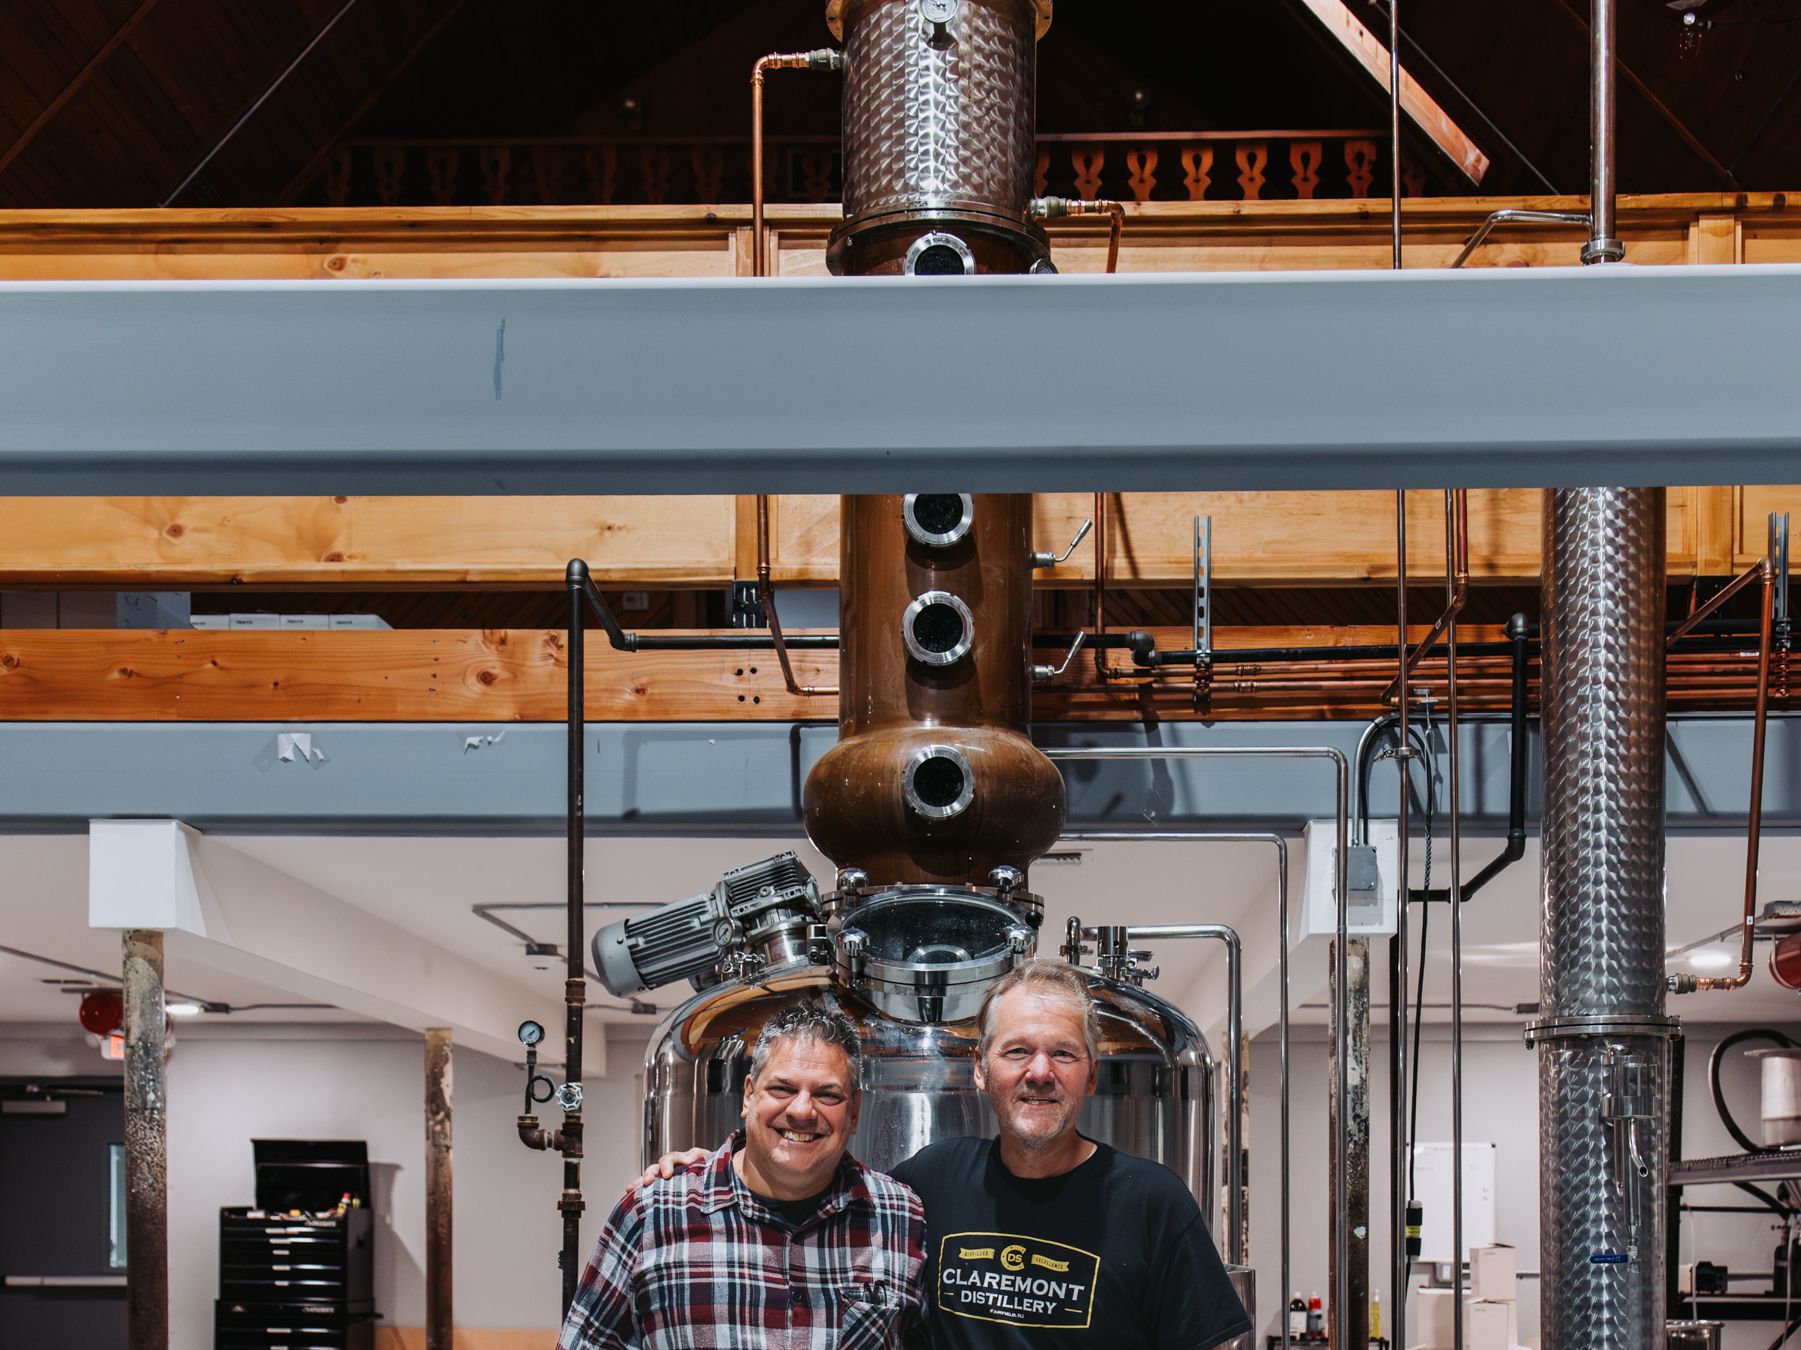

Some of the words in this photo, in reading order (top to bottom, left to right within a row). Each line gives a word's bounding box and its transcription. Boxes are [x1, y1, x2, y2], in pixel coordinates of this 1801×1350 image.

[1007, 1253, 1023, 1263] DS
[1035, 1257, 1064, 1270] EXCELLENCE
[942, 1268, 1086, 1301] CLAREMONT
[960, 1290, 1058, 1315] DISTILLERY
